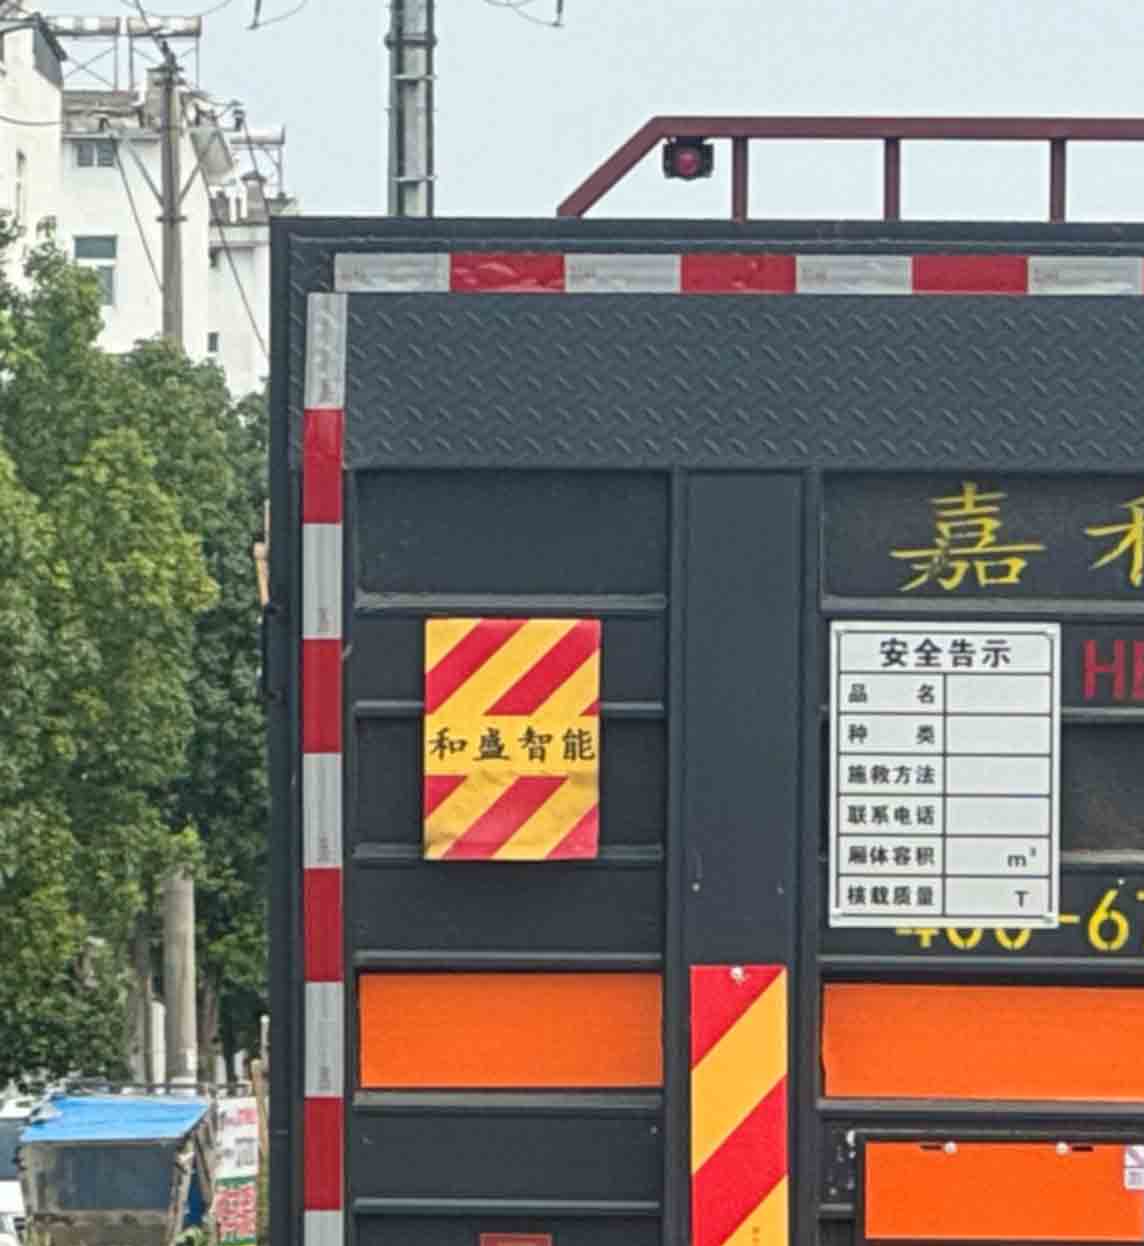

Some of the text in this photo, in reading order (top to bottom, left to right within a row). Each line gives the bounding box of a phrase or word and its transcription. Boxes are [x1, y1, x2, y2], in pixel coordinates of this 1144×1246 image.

[880, 638, 1011, 667] 安全告示
[428, 727, 596, 763] 和盛智能
[847, 765, 935, 785] 施救方法
[847, 805, 935, 825] 联系电话
[847, 885, 1029, 907] 核载质量 T
